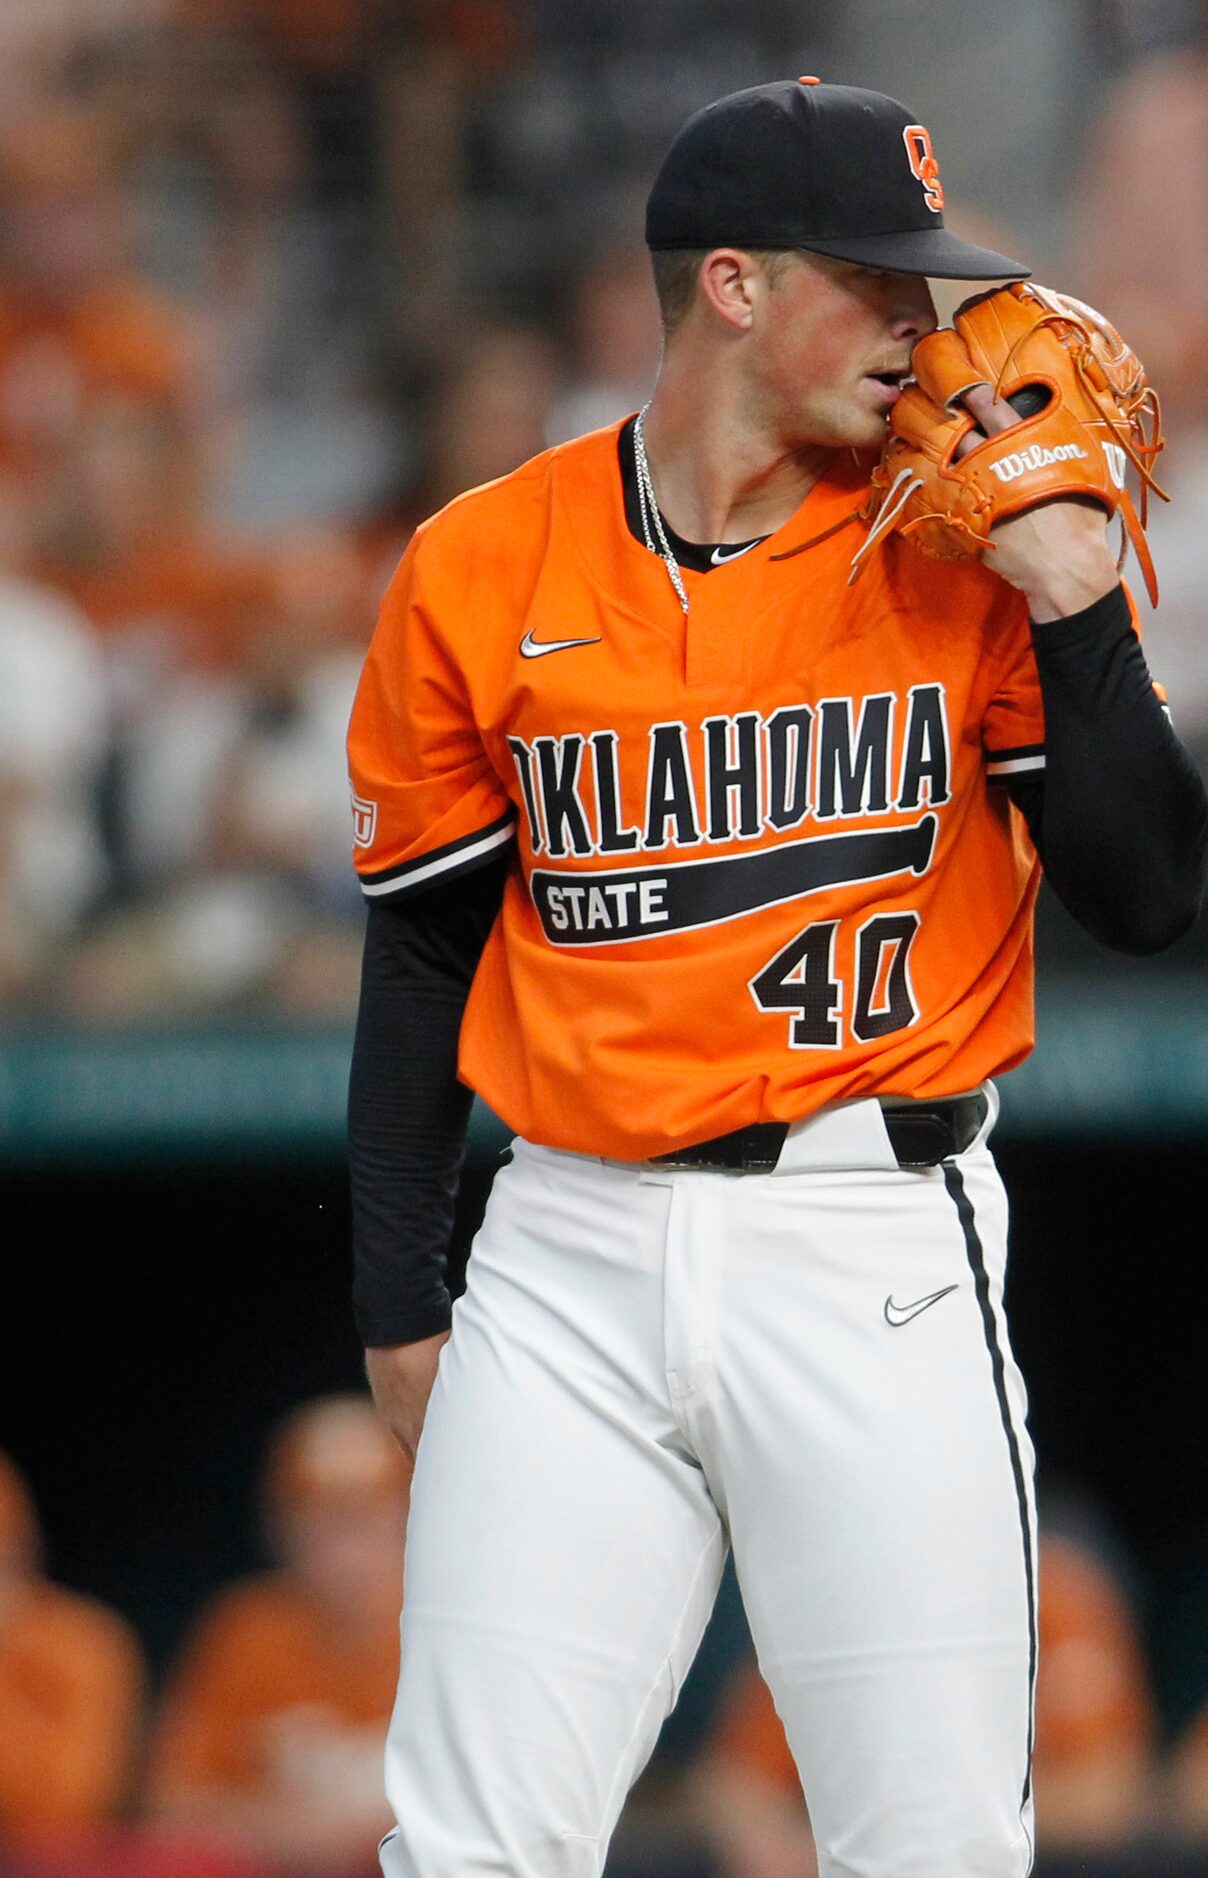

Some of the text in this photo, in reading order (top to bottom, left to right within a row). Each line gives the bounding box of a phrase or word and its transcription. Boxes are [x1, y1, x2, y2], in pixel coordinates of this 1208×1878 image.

[989, 443, 1088, 482] Wilson
[546, 878, 669, 930] STATE
[746, 910, 922, 1050] 40
